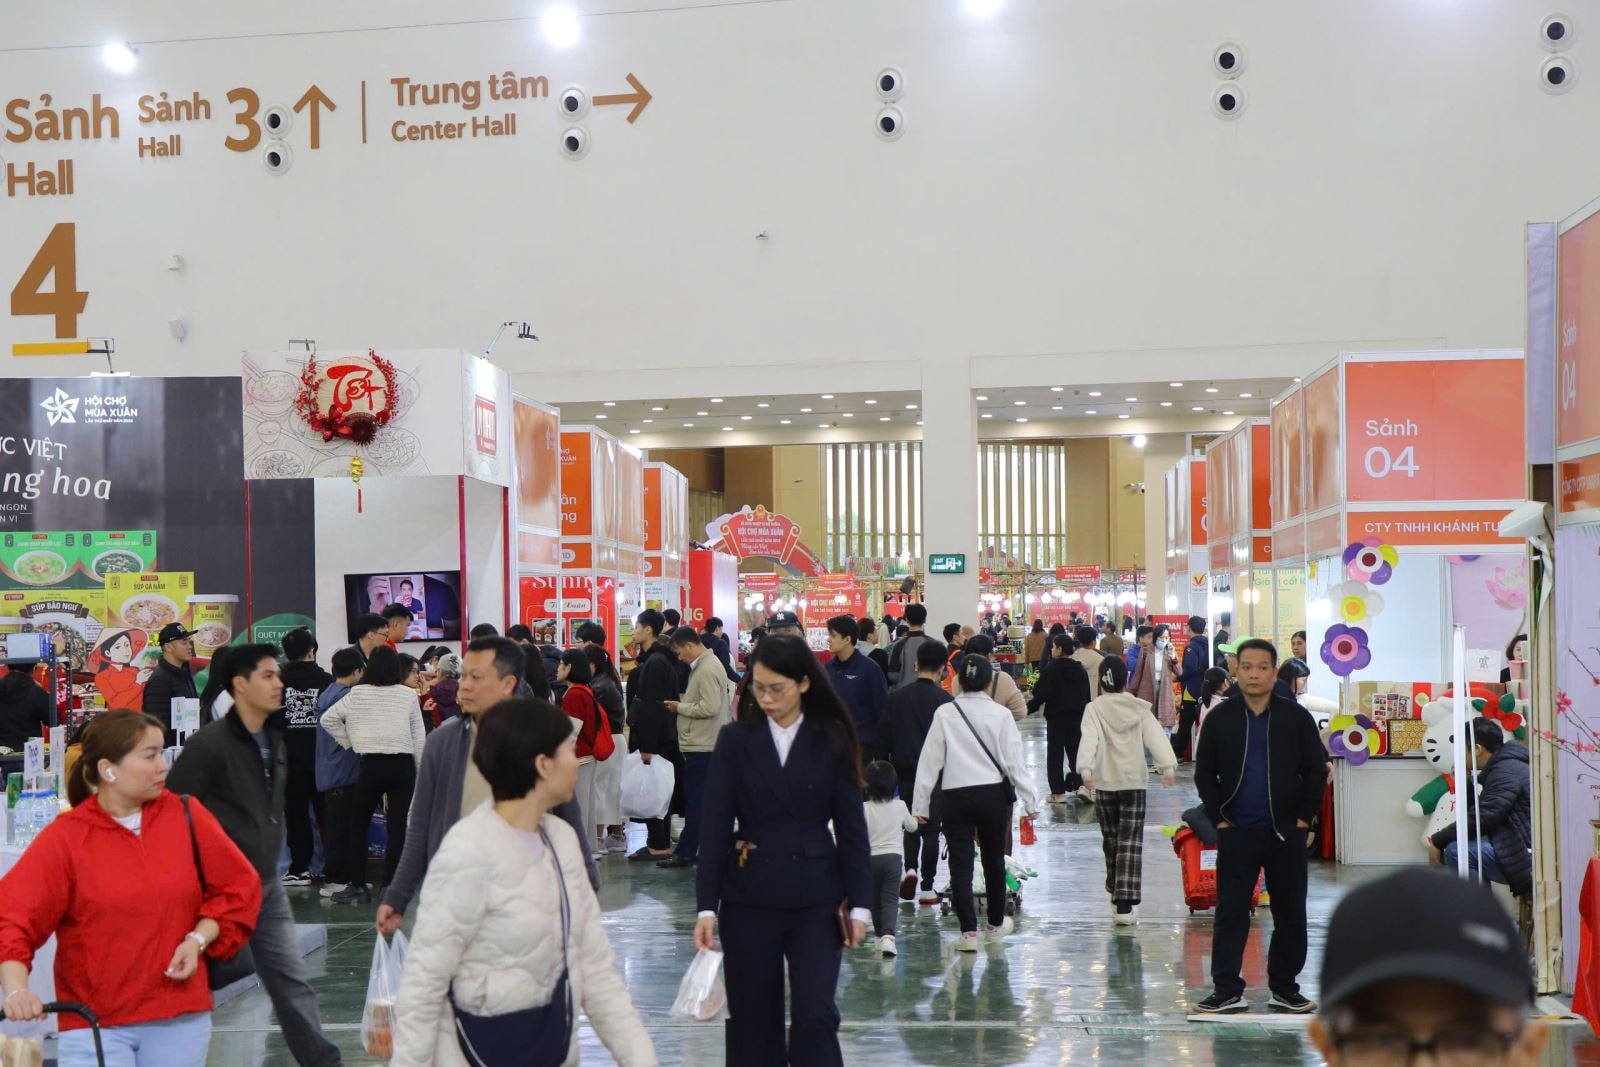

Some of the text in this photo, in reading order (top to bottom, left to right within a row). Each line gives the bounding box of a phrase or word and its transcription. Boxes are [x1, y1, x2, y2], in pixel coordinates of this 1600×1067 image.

[390, 71, 549, 112] Trung tâm
[5, 93, 120, 144] Sảnh
[138, 87, 262, 152] Sảnh 3
[391, 113, 517, 143] Center Hall
[138, 135, 182, 159] Hall
[6, 159, 74, 197] Hall
[10, 222, 90, 338] 4
[84, 394, 127, 408] HỘI CHỢ
[326, 364, 386, 412] Tết
[1562, 360, 1577, 412] 04
[84, 406, 138, 417] MÙA XUÂN
[1365, 418, 1419, 437] Sảnh
[22, 436, 68, 462] VIỆT
[1364, 446, 1420, 478] 04
[52, 466, 112, 500] hoa
[1365, 522, 1392, 533] CTY
[1394, 522, 1431, 533] TNHH
[1433, 519, 1480, 533] KHÁNH
[31, 602, 46, 612] SÚP
